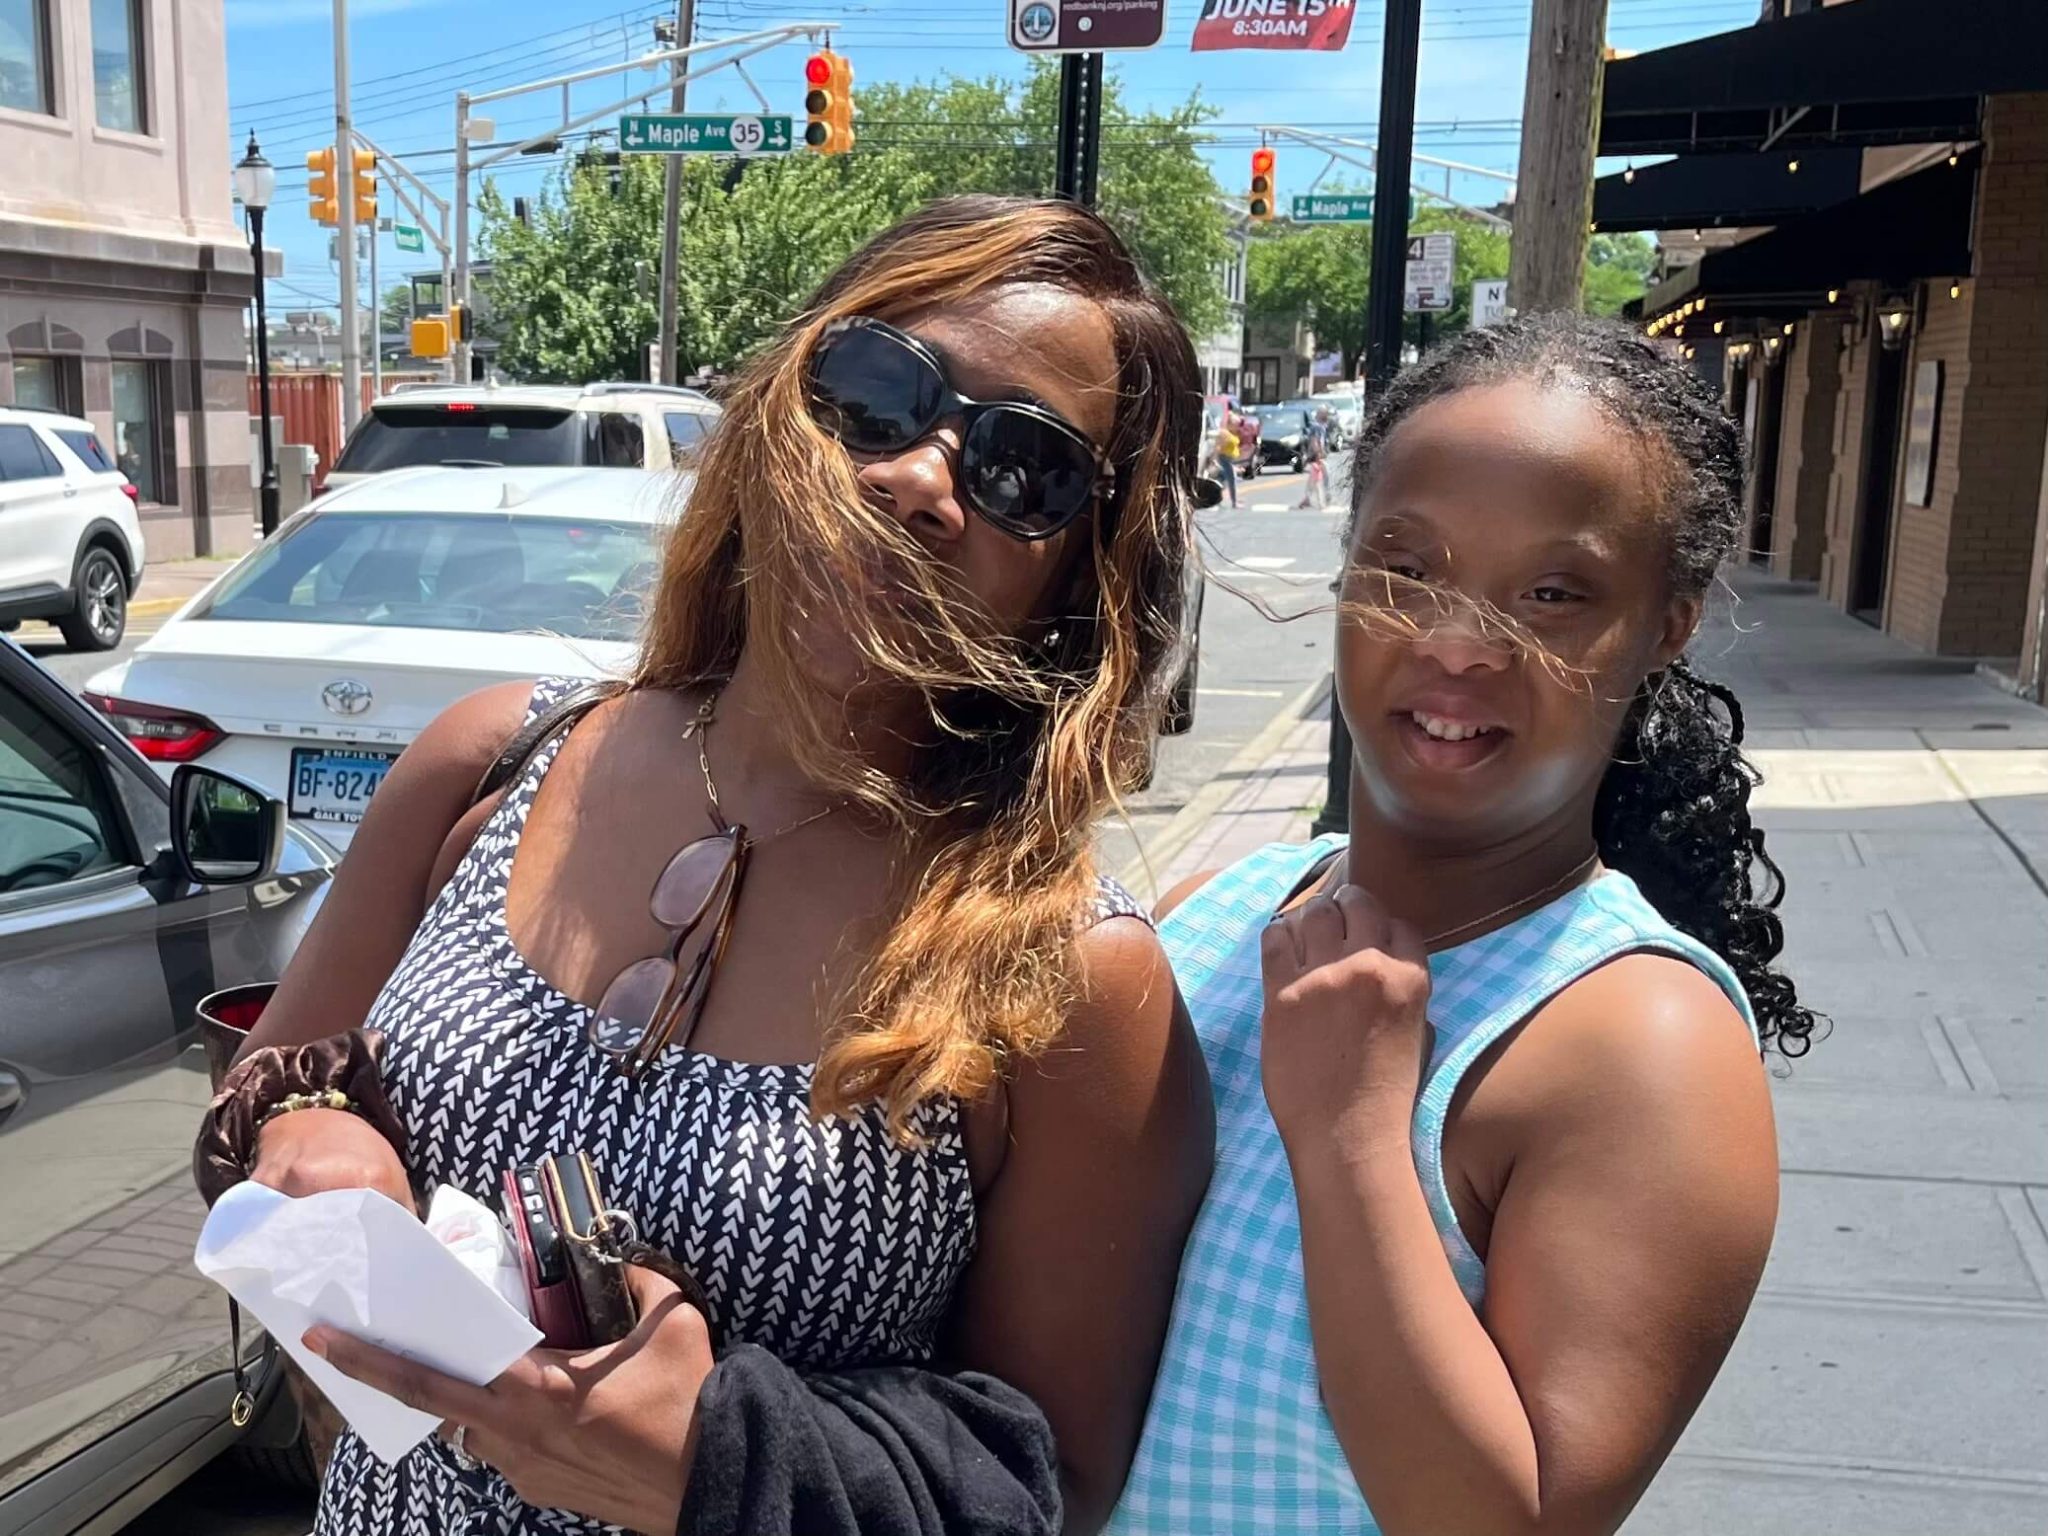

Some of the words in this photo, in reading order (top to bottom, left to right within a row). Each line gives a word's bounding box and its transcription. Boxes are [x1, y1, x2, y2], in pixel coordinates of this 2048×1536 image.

[1206, 0, 1286, 20] JUNE
[1232, 20, 1307, 36] 8:30AM
[630, 121, 638, 133] N
[734, 124, 760, 143] 35
[774, 121, 782, 133] S
[648, 123, 699, 147] Maple
[705, 124, 726, 137] Ave
[1312, 201, 1349, 218] Maple
[1489, 287, 1500, 300] N
[324, 749, 388, 760] ENFIELD
[314, 810, 341, 822] GALE
